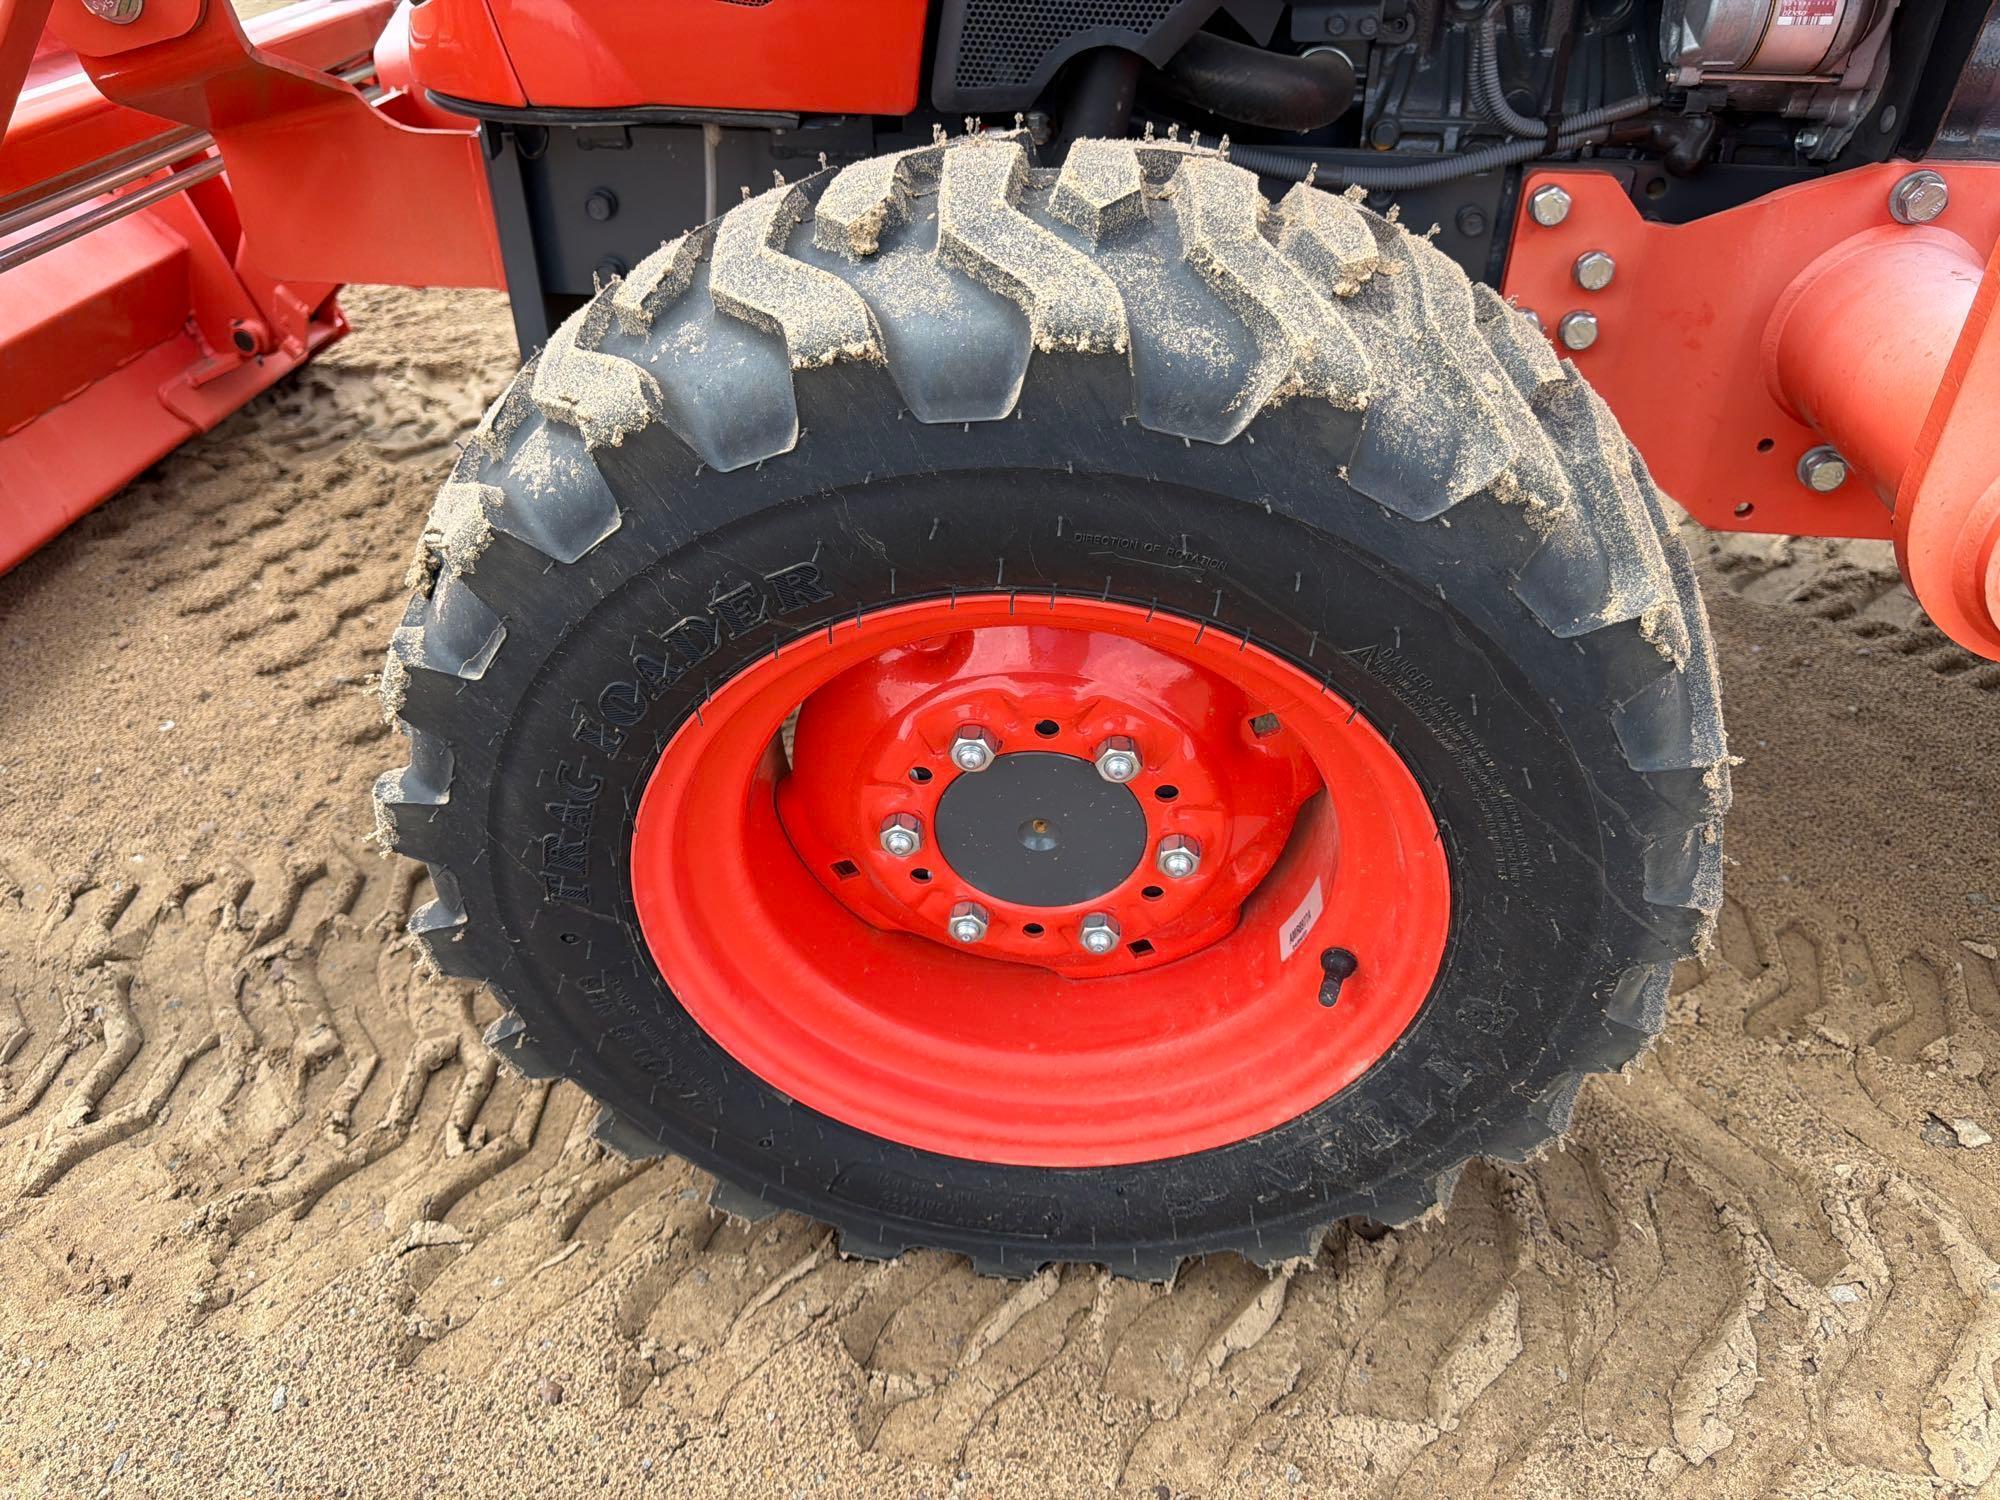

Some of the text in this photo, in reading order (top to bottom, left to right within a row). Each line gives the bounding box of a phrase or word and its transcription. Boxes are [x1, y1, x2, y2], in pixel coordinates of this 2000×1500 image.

[1073, 532, 1229, 571] DIRECTION OF ROTATION
[1380, 647, 1433, 690] DANGER
[542, 560, 835, 904] TRAC LOADER
